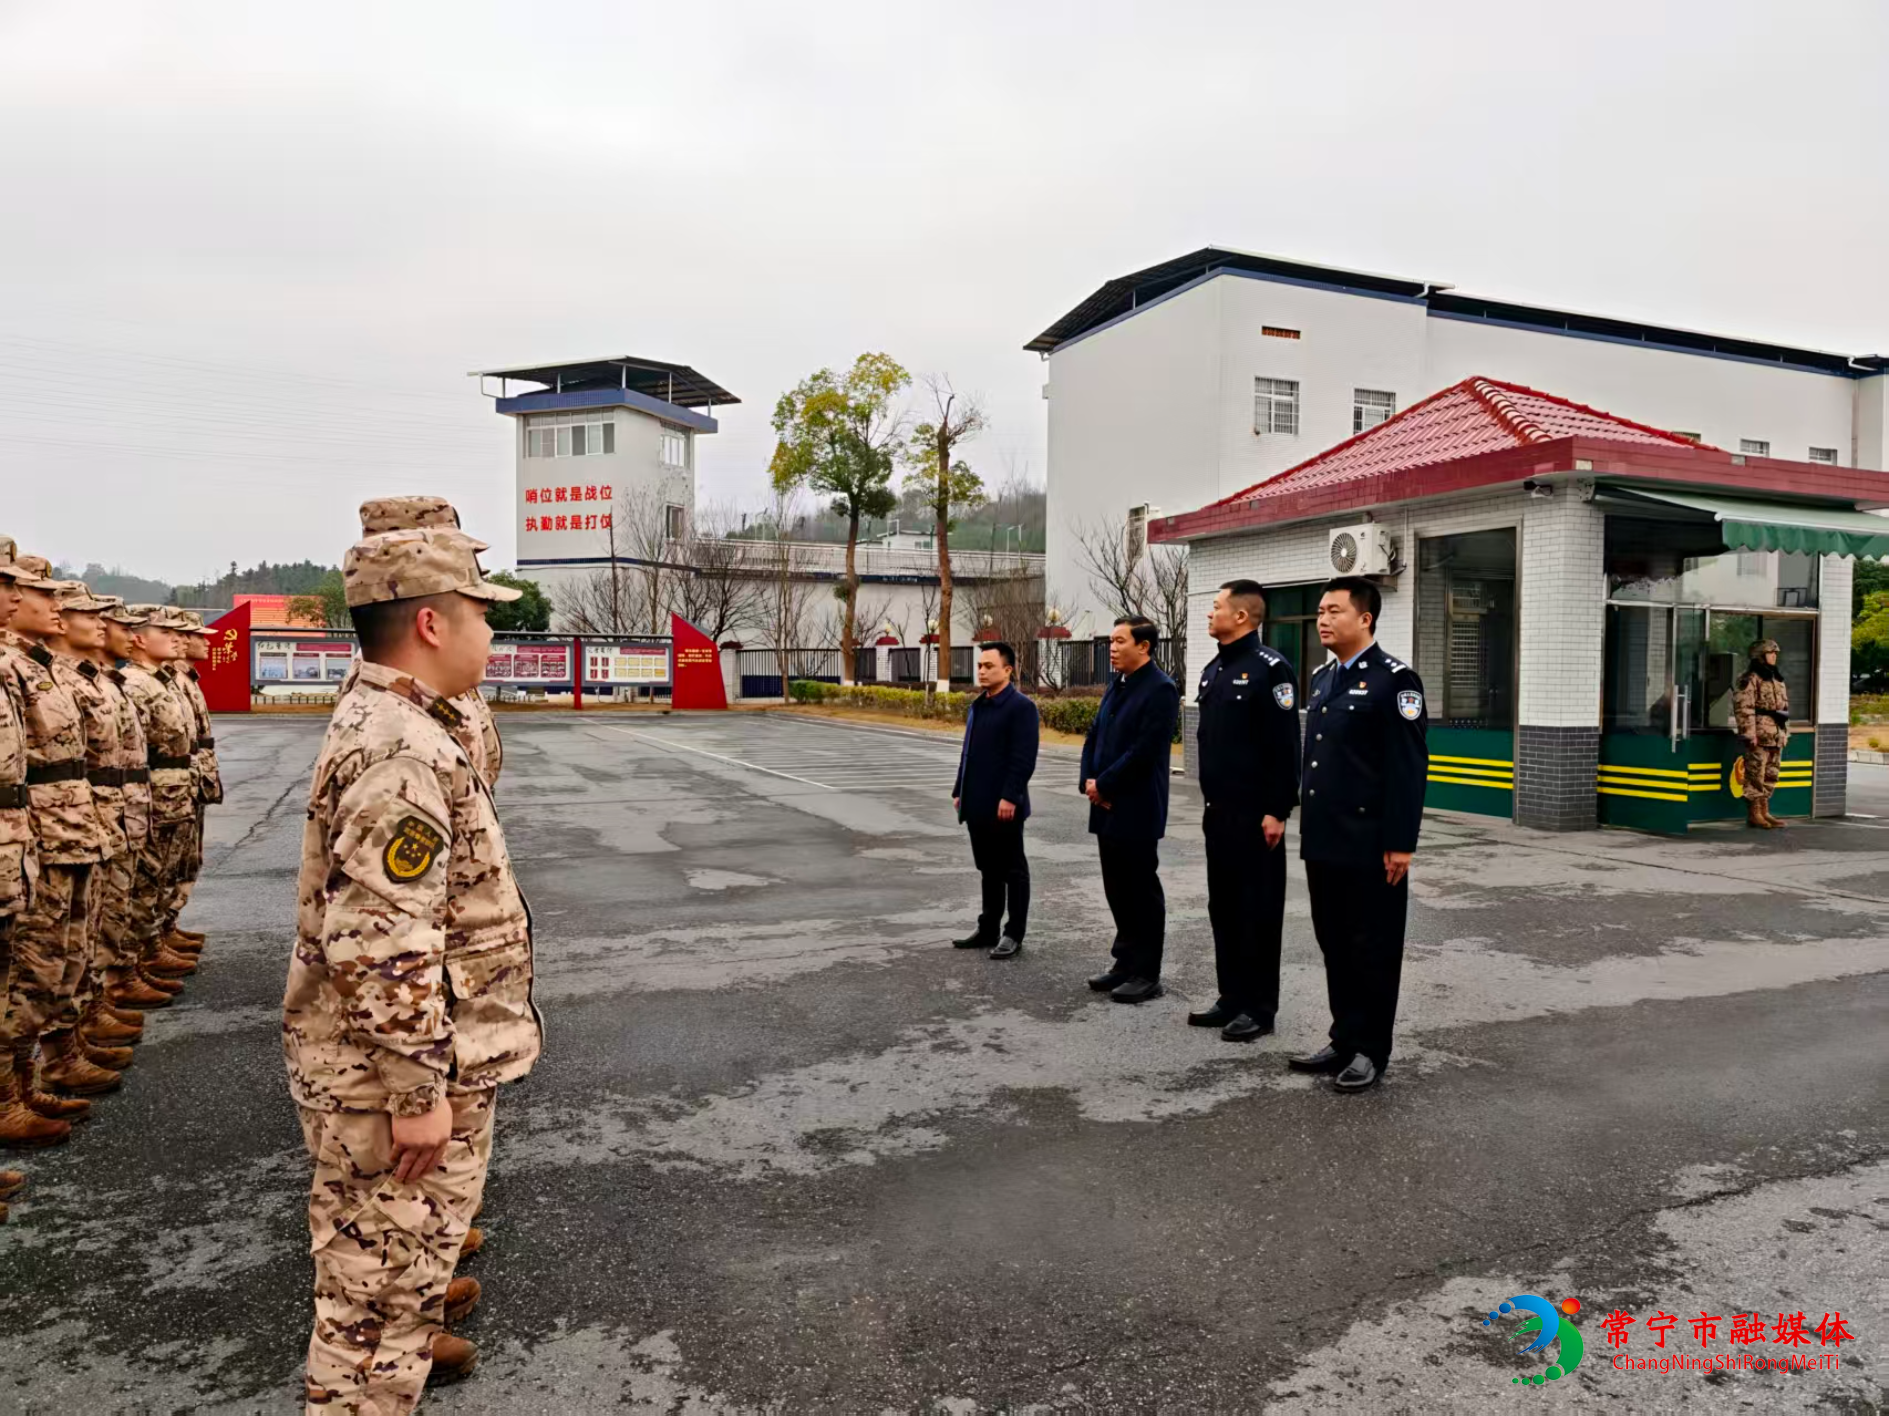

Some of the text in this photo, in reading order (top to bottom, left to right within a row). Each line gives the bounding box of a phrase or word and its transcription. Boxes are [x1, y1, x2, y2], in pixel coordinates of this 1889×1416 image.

[525, 485, 612, 504] 哨位就是战位
[526, 513, 612, 532] 执勤就是打仗
